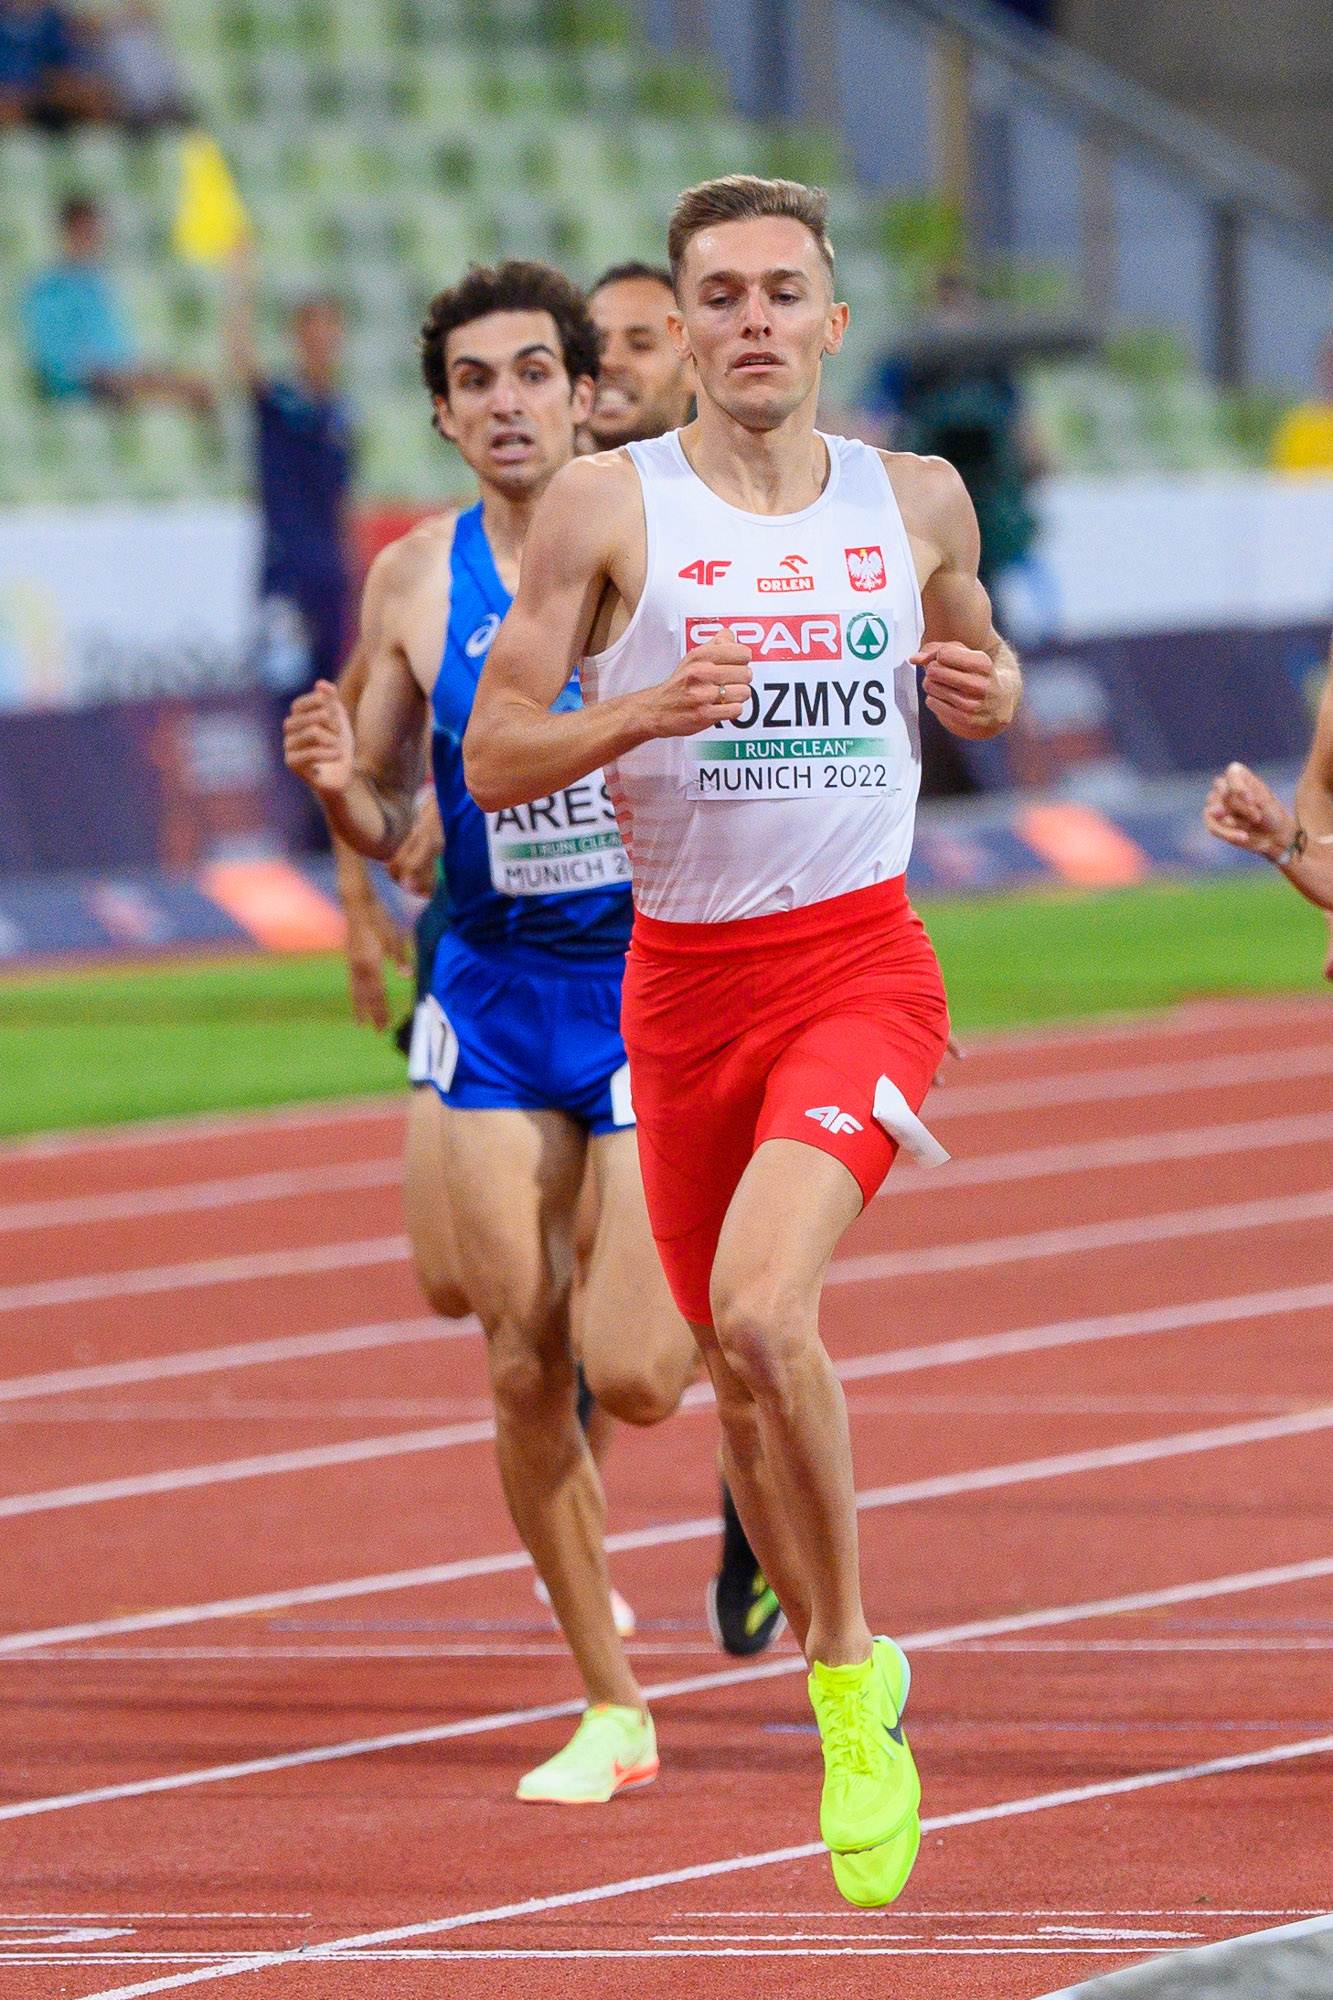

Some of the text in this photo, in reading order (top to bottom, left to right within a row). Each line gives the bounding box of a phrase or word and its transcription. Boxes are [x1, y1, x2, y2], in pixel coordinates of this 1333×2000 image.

[678, 559, 732, 586] 4F
[759, 577, 812, 592] ORLEN
[689, 619, 838, 656] SPAR
[714, 680, 887, 729] OZMYS
[735, 742, 740, 758] I
[745, 742, 785, 758] RUN
[700, 764, 887, 791] MUNICH 2022
[505, 857, 605, 889] MUNICH
[804, 1105, 864, 1135] 4F
